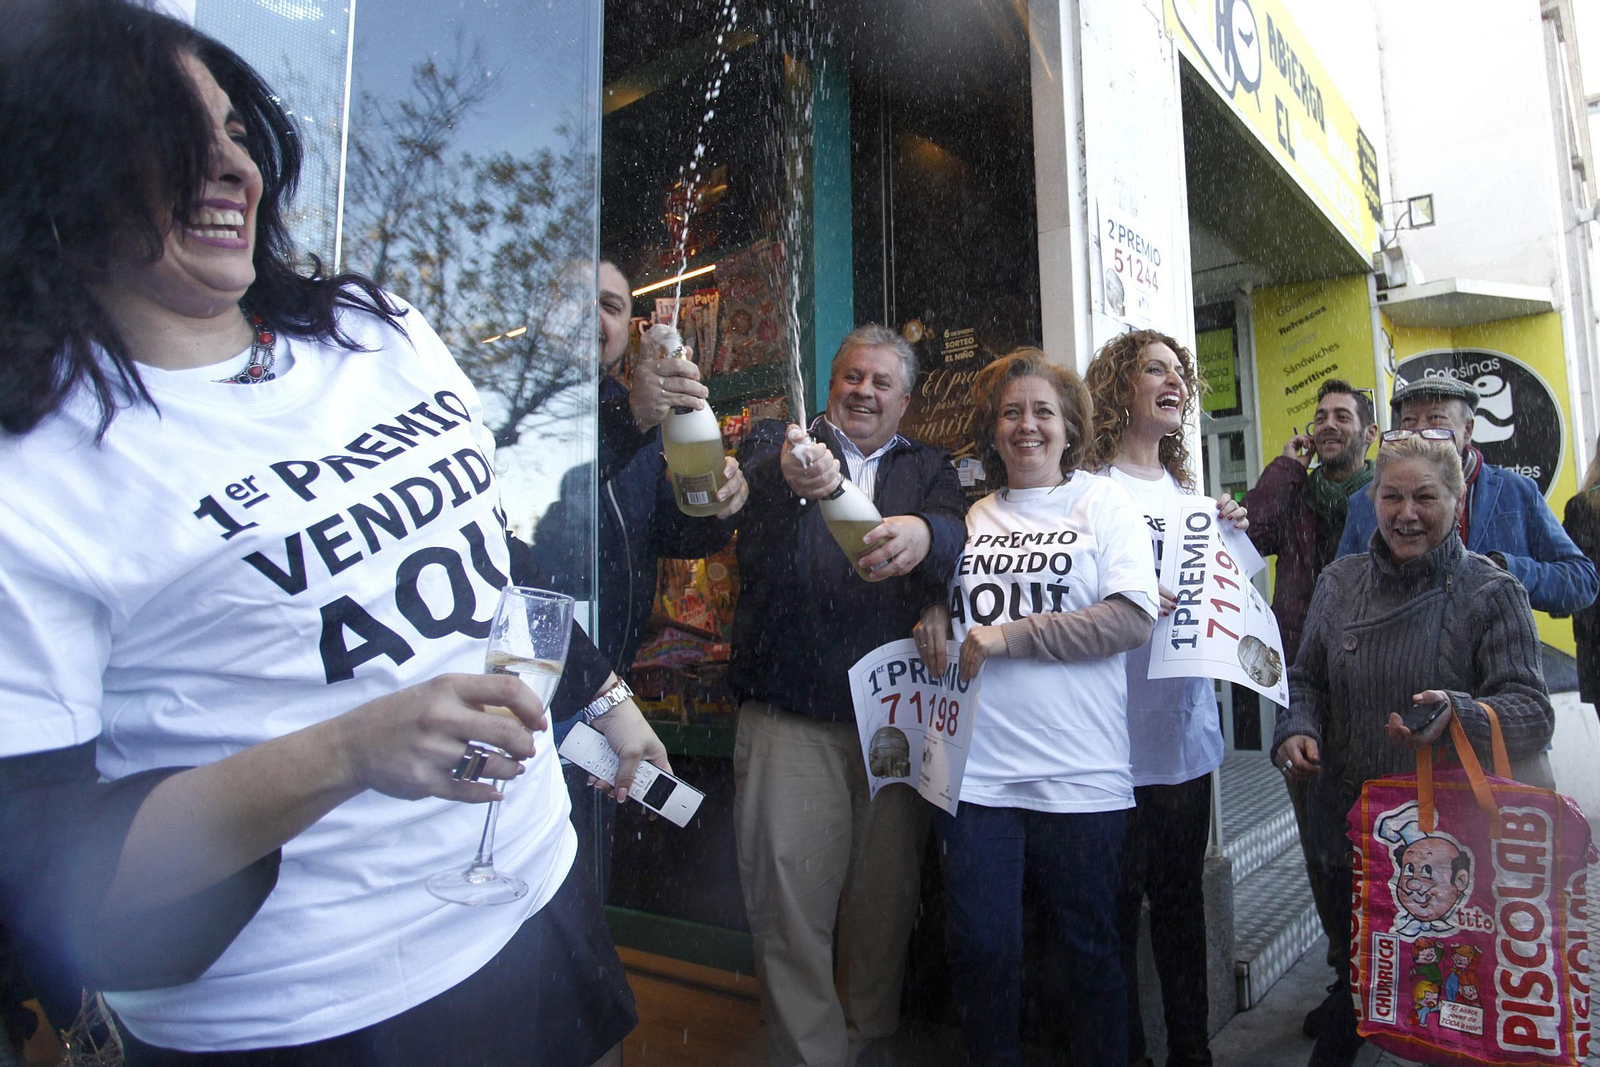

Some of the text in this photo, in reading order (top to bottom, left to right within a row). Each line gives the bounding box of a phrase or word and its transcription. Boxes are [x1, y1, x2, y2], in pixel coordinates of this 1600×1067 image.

[1275, 94, 1296, 161] EL
[1119, 224, 1161, 267] PREMIO
[1114, 248, 1159, 294] 51244
[944, 328, 950, 339] 6
[944, 337, 975, 350] SORTEO
[1278, 305, 1327, 336] Refrescos
[944, 350, 975, 363] EL NIÑO
[1284, 362, 1339, 396] Aperitivos
[1424, 358, 1500, 379] Golosinas
[269, 390, 472, 502] PREMIO
[974, 530, 1078, 549] PREMIO
[1174, 512, 1212, 626] PREMIO
[1207, 535, 1240, 641] 7119
[319, 505, 509, 685] AQU
[951, 578, 1070, 627] AQUÍ
[881, 691, 960, 737] 71198
[1456, 907, 1493, 931] tito
[1500, 811, 1556, 1050] PISCOLAB
[1375, 938, 1395, 1017] CHURRUCA
